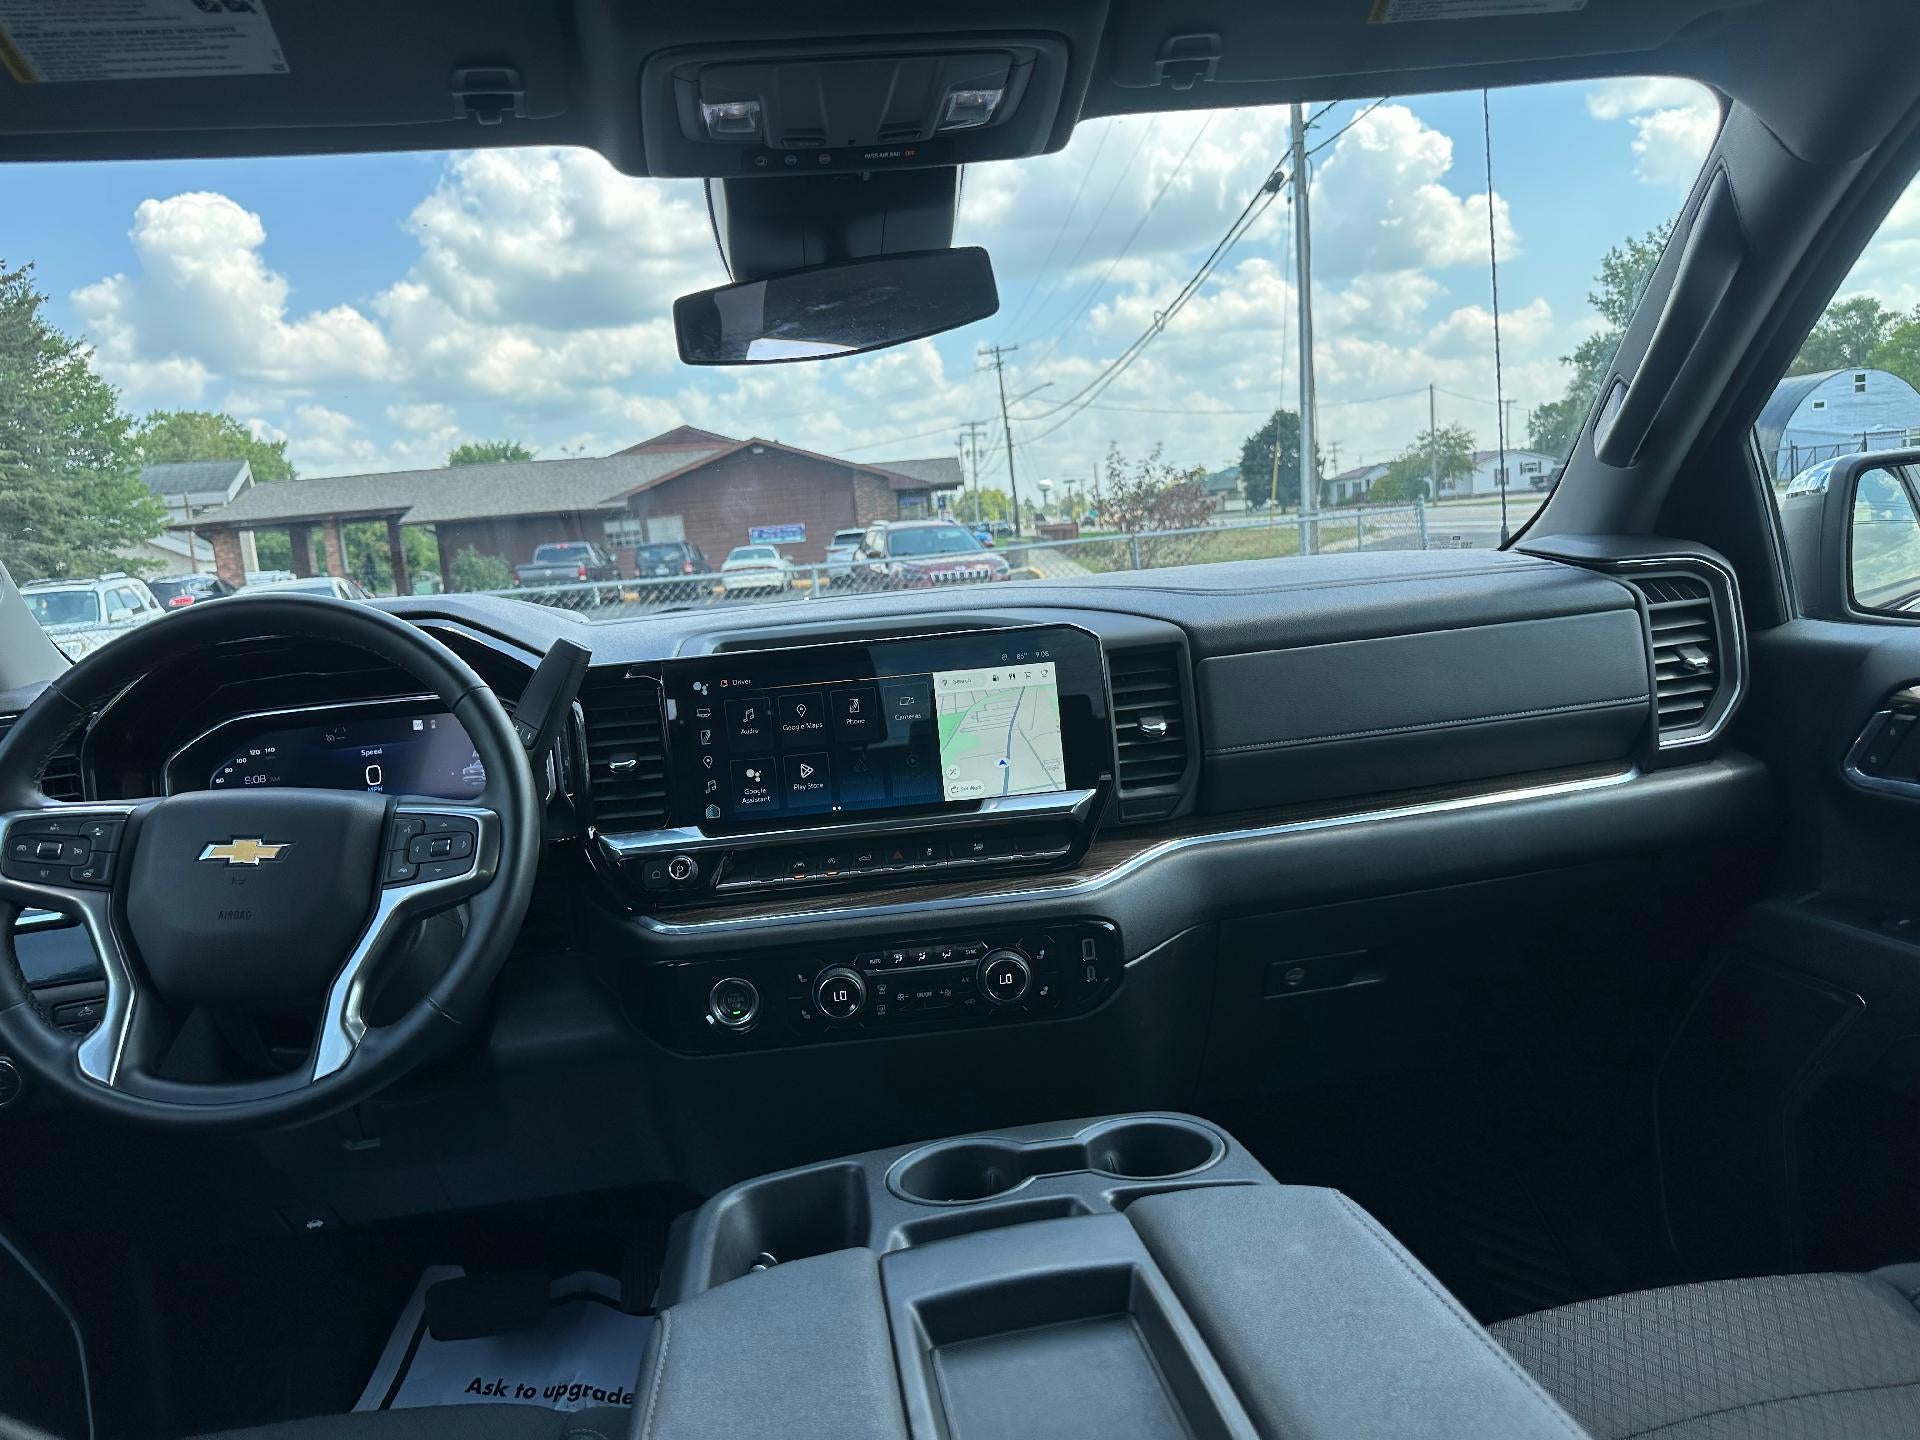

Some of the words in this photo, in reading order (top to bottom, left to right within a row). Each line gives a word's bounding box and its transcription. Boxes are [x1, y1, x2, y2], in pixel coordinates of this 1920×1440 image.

[732, 678, 752, 687] Driver
[846, 717, 866, 725] Phone
[894, 713, 922, 721] Cameras
[740, 727, 759, 735] Audio
[782, 723, 805, 733] Google
[806, 722, 823, 731] Maps
[360, 747, 383, 758] Speed
[365, 764, 382, 786] 0
[793, 783, 807, 791] Play
[807, 782, 824, 790] Store
[744, 787, 767, 796] Google
[741, 795, 771, 804] Assistant
[217, 910, 252, 920] AIRBAG
[464, 1376, 511, 1397] Ask
[514, 1383, 537, 1399] to
[543, 1382, 634, 1405] upgrade
